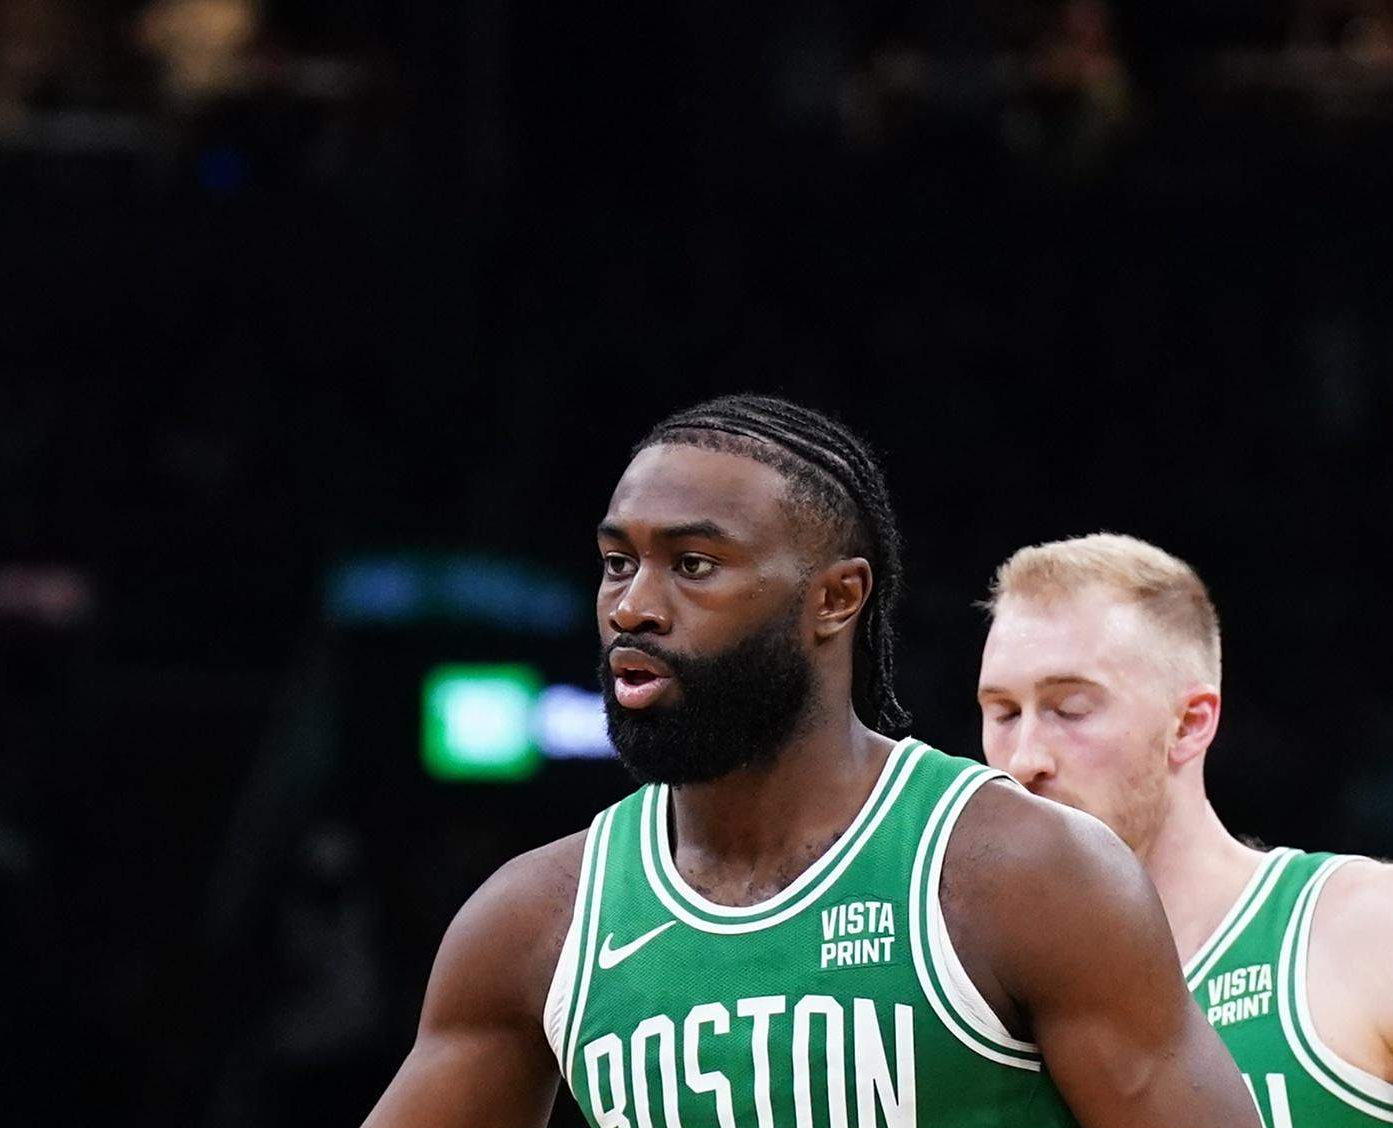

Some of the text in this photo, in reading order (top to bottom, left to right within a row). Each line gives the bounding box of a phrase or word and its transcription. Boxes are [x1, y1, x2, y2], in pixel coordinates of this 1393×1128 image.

[821, 901, 895, 940] VISTA
[820, 936, 895, 969] PRINT
[1207, 963, 1272, 1006] VISTA
[1207, 991, 1272, 1027] PRINT
